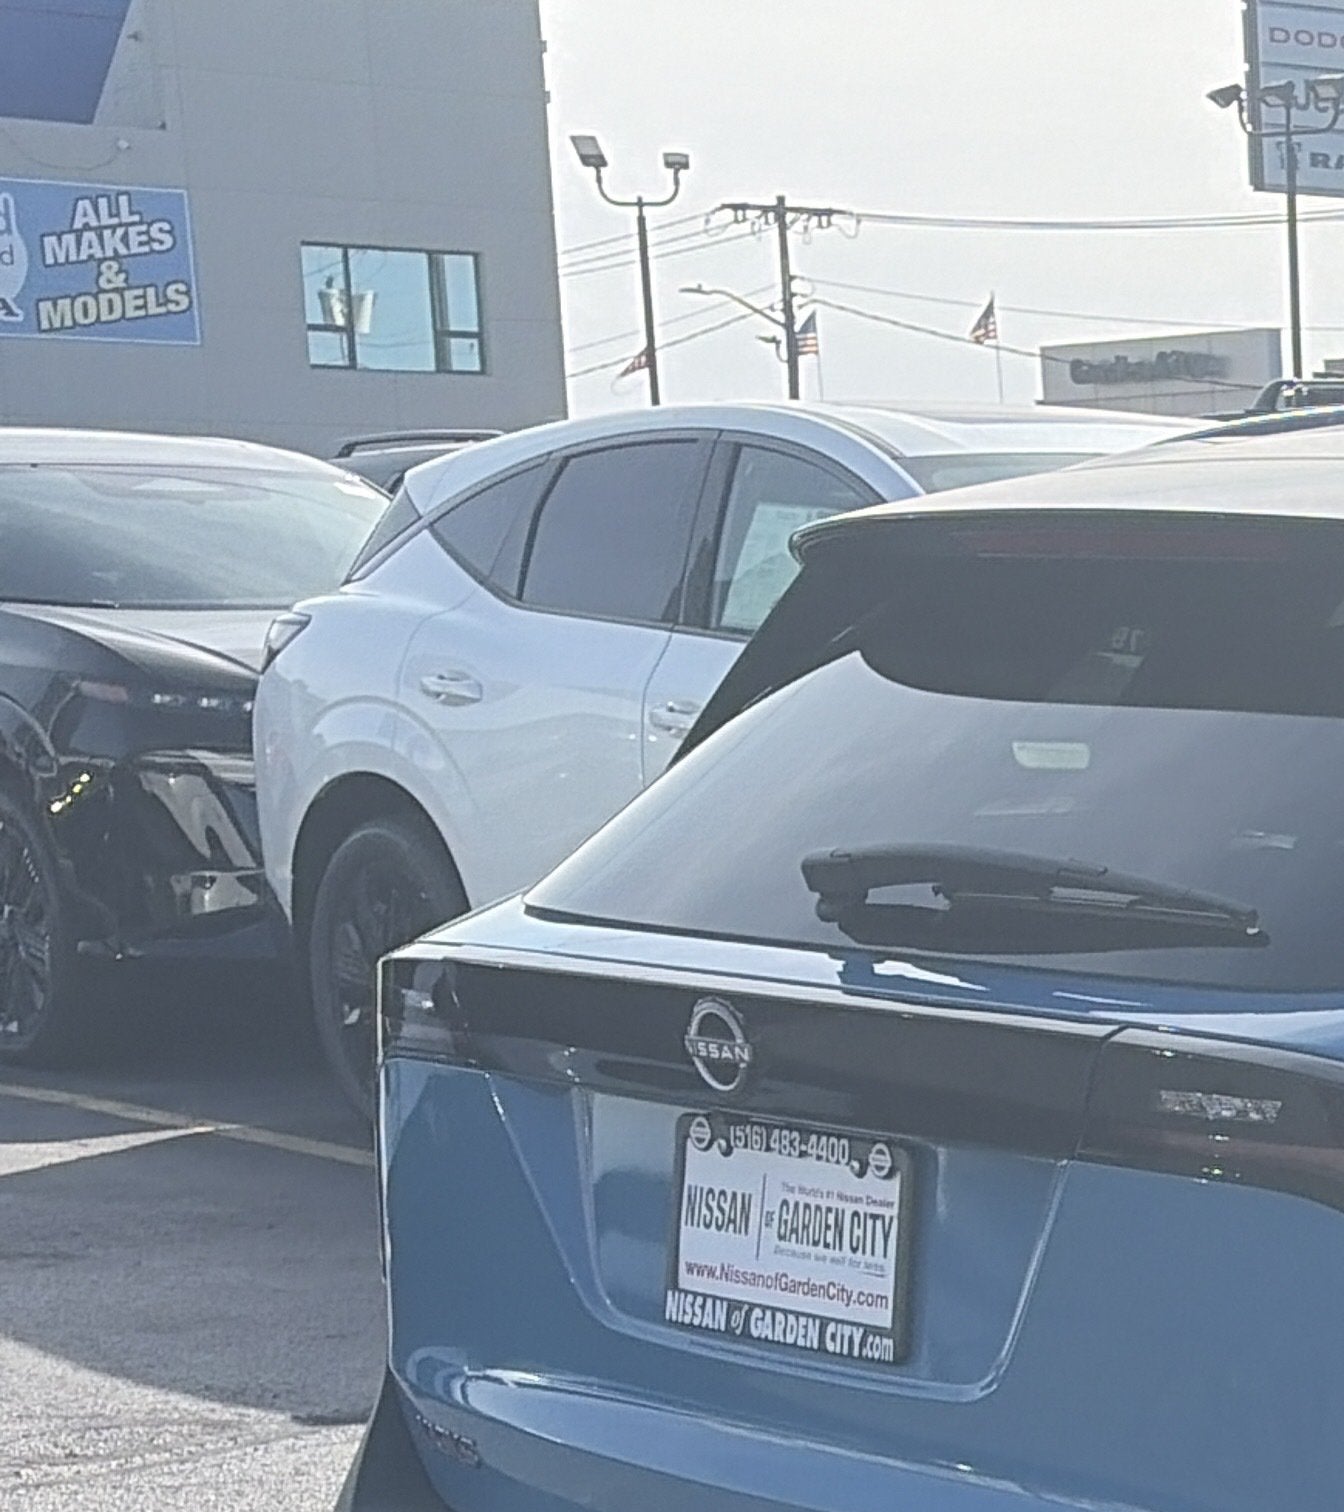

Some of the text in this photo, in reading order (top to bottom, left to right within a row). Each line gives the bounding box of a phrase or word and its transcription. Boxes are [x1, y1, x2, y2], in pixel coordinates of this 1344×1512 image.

[71, 194, 142, 230] ALL
[42, 221, 174, 266] MAKES
[98, 260, 128, 290] &
[38, 282, 191, 331] MODELS
[730, 1124, 850, 1167] (516) 483-4400
[685, 1184, 752, 1236] NISSAN
[777, 1198, 845, 1252] GARDEN
[849, 1210, 894, 1259] CITY
[685, 1260, 889, 1309] www.NissanofGardenCity.com
[665, 1289, 894, 1362] NISSAN of GARDEN CITY.com
